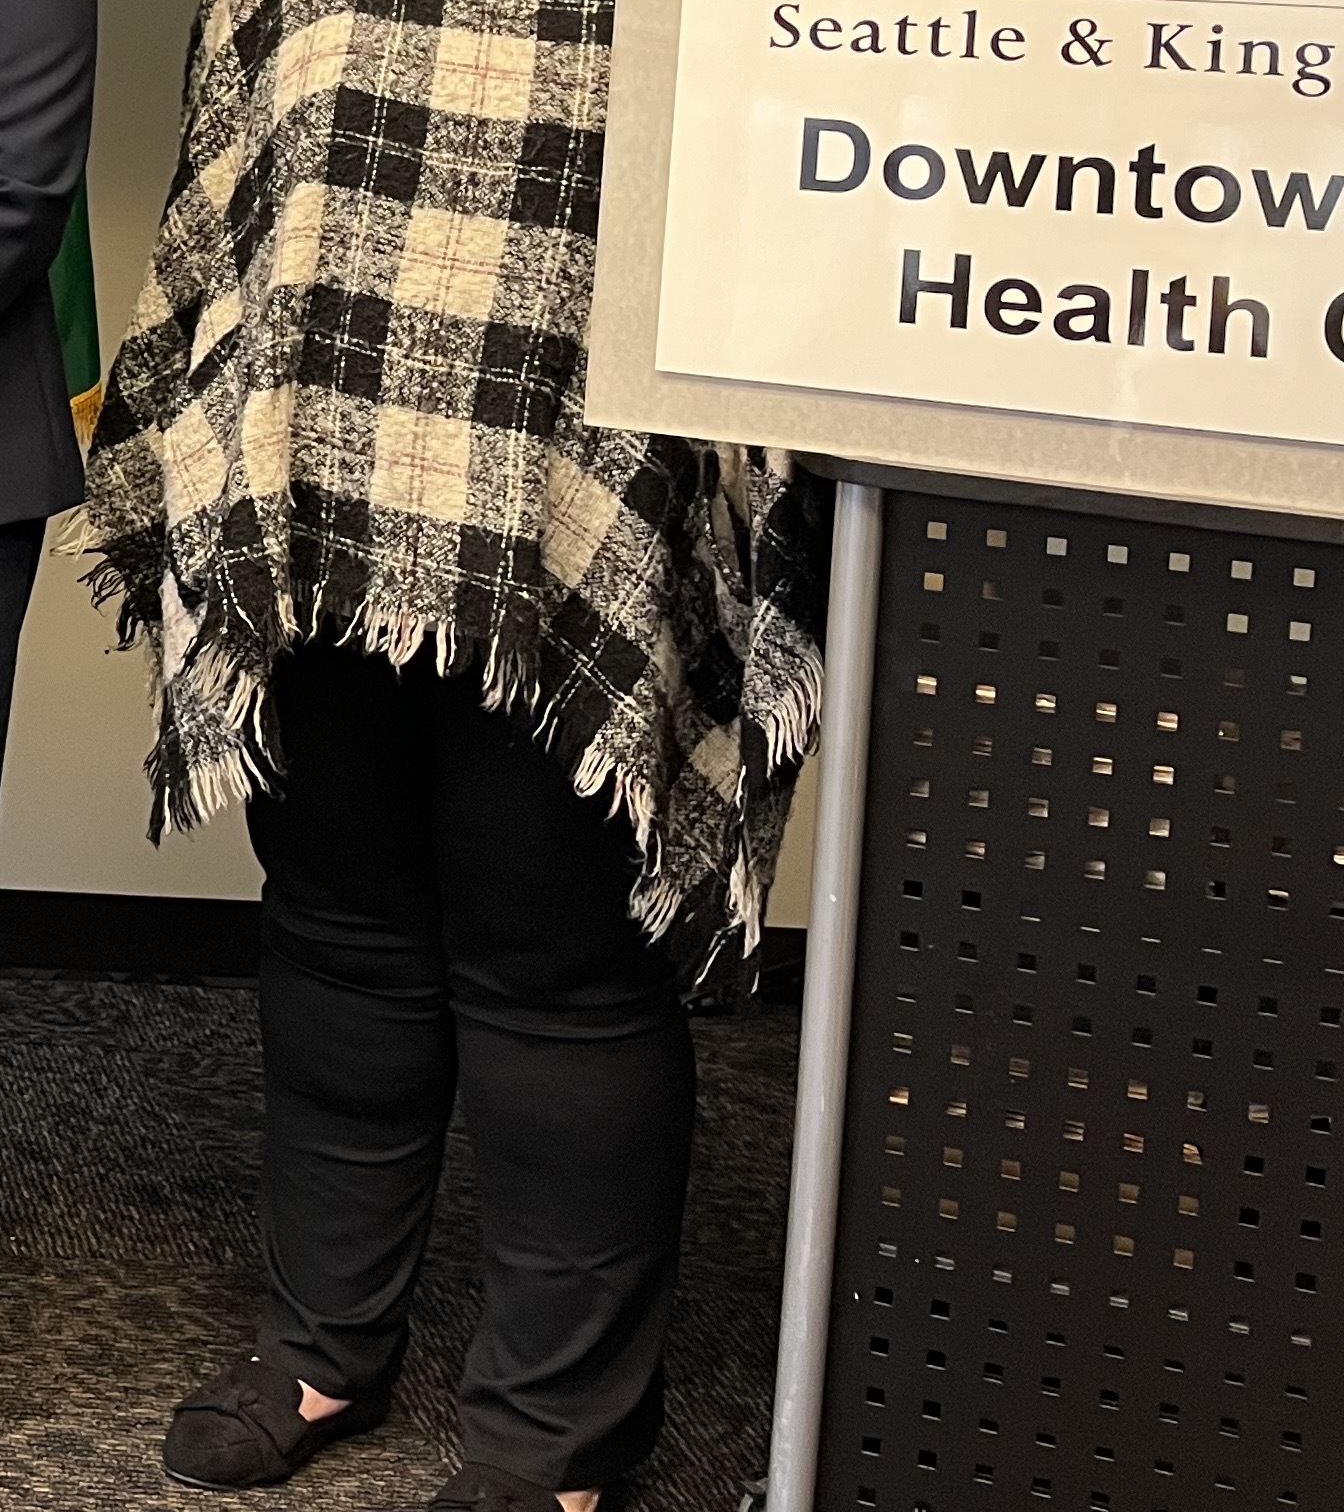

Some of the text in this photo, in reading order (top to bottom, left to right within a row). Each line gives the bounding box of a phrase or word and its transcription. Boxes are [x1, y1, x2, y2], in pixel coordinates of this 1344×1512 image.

[769, 3, 1336, 98] Seattle & King
[798, 117, 1344, 232] Downtow
[898, 249, 1271, 359] Health
